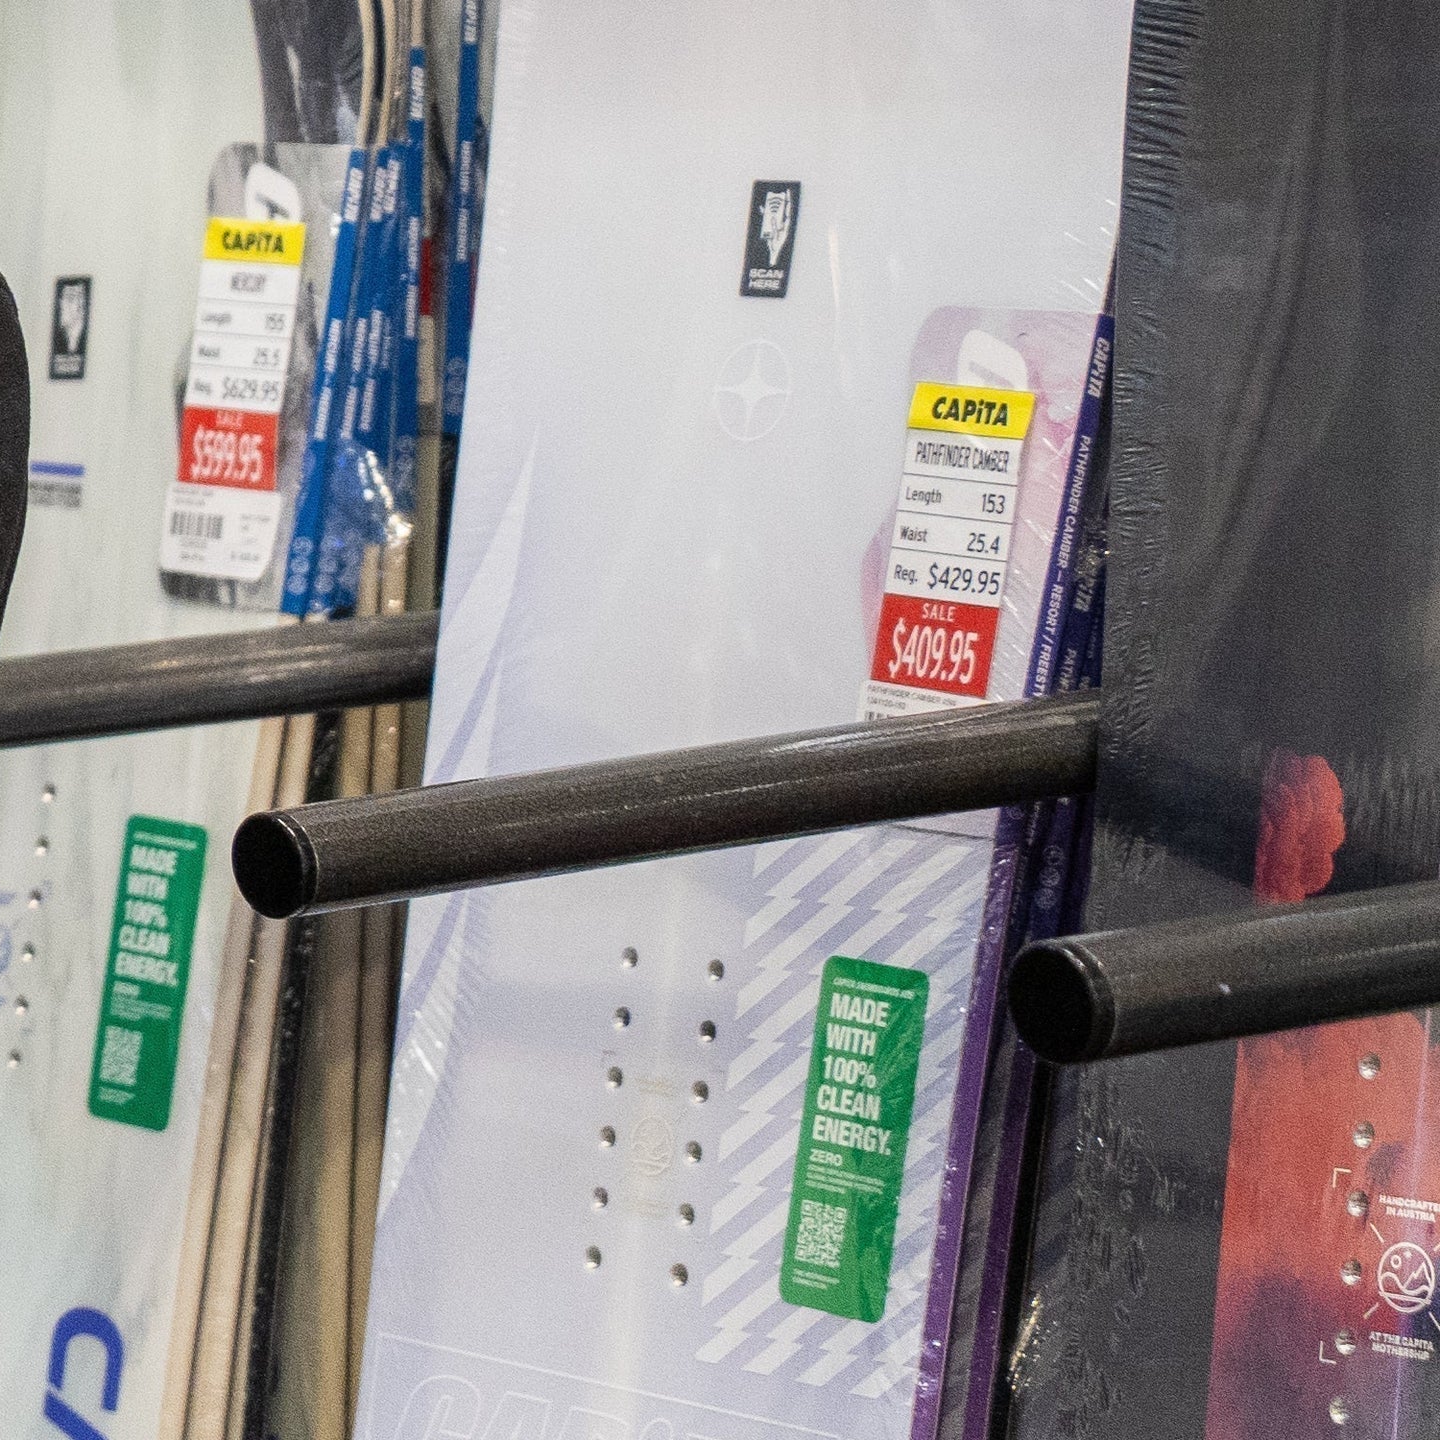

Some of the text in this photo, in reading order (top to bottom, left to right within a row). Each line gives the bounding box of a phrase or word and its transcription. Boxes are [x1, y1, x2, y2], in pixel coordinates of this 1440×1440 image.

[916, 441, 1010, 474] PATHFINDER CAMBER
[905, 486, 1006, 514] Length 153
[899, 526, 1001, 555] Waist 25.4
[893, 563, 1001, 596] Reg. $429.95
[921, 602, 956, 623] SALE
[887, 618, 979, 685] $409.95
[830, 992, 890, 1028] MADE
[826, 1022, 878, 1056] WITH
[822, 1054, 878, 1089] 100%
[816, 1083, 881, 1121] CLEAN
[812, 1114, 893, 1155] ENERGY.
[809, 1148, 843, 1167] ZERO
[1396, 1208, 1436, 1222] AUSTRIA
